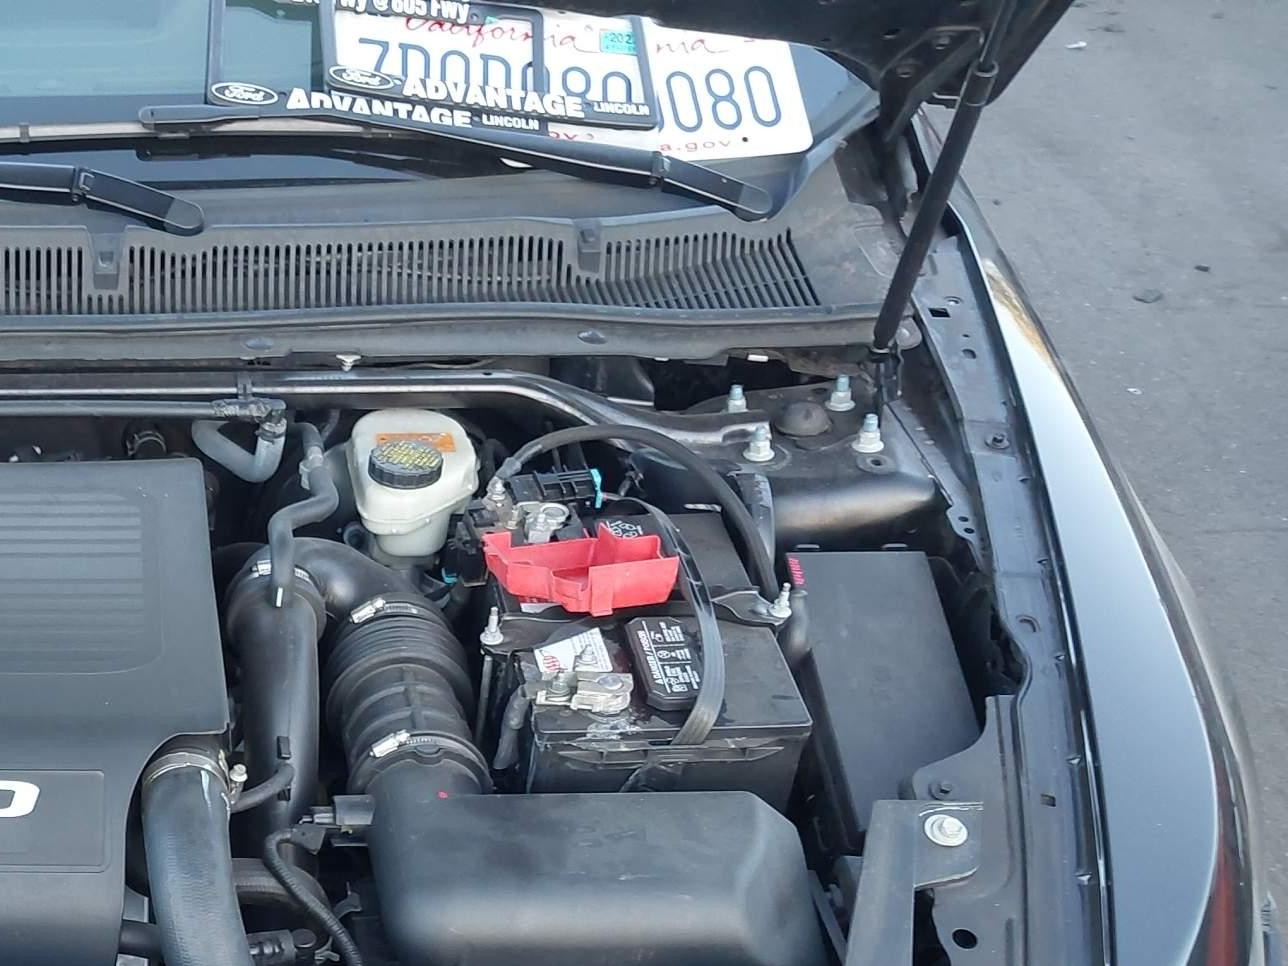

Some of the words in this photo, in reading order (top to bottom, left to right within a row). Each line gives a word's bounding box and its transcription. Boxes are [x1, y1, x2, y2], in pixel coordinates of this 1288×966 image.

[430, 0, 469, 24] Fwy
[402, 77, 585, 119] ADVANTAGE
[594, 102, 650, 116] LINCOLN
[482, 114, 540, 130] LINCOLN
